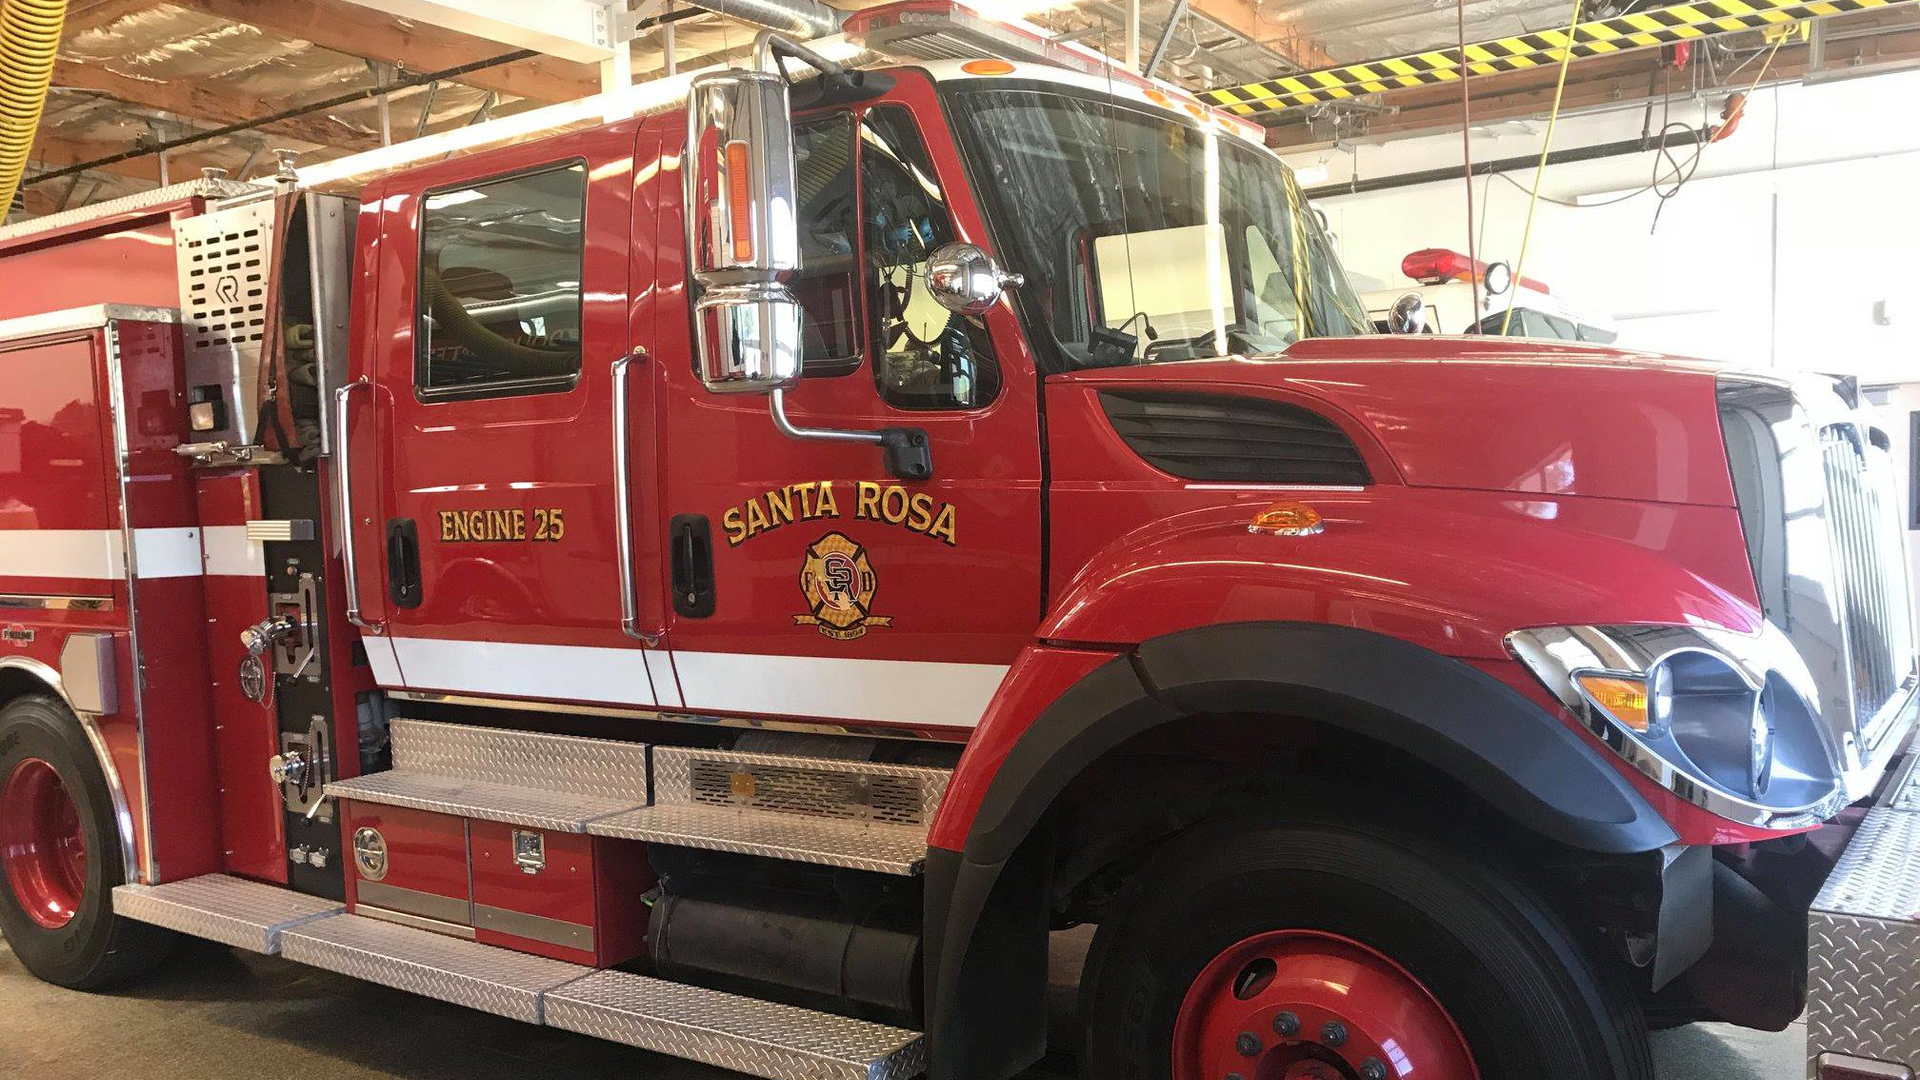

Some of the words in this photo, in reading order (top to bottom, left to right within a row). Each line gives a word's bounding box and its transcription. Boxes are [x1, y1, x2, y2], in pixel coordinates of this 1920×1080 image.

[439, 509, 526, 542] ENGINE
[533, 508, 565, 542] 25
[722, 481, 840, 547] SANTA
[853, 481, 957, 547] ROSA
[861, 571, 873, 592] D
[820, 626, 842, 638] EST.
